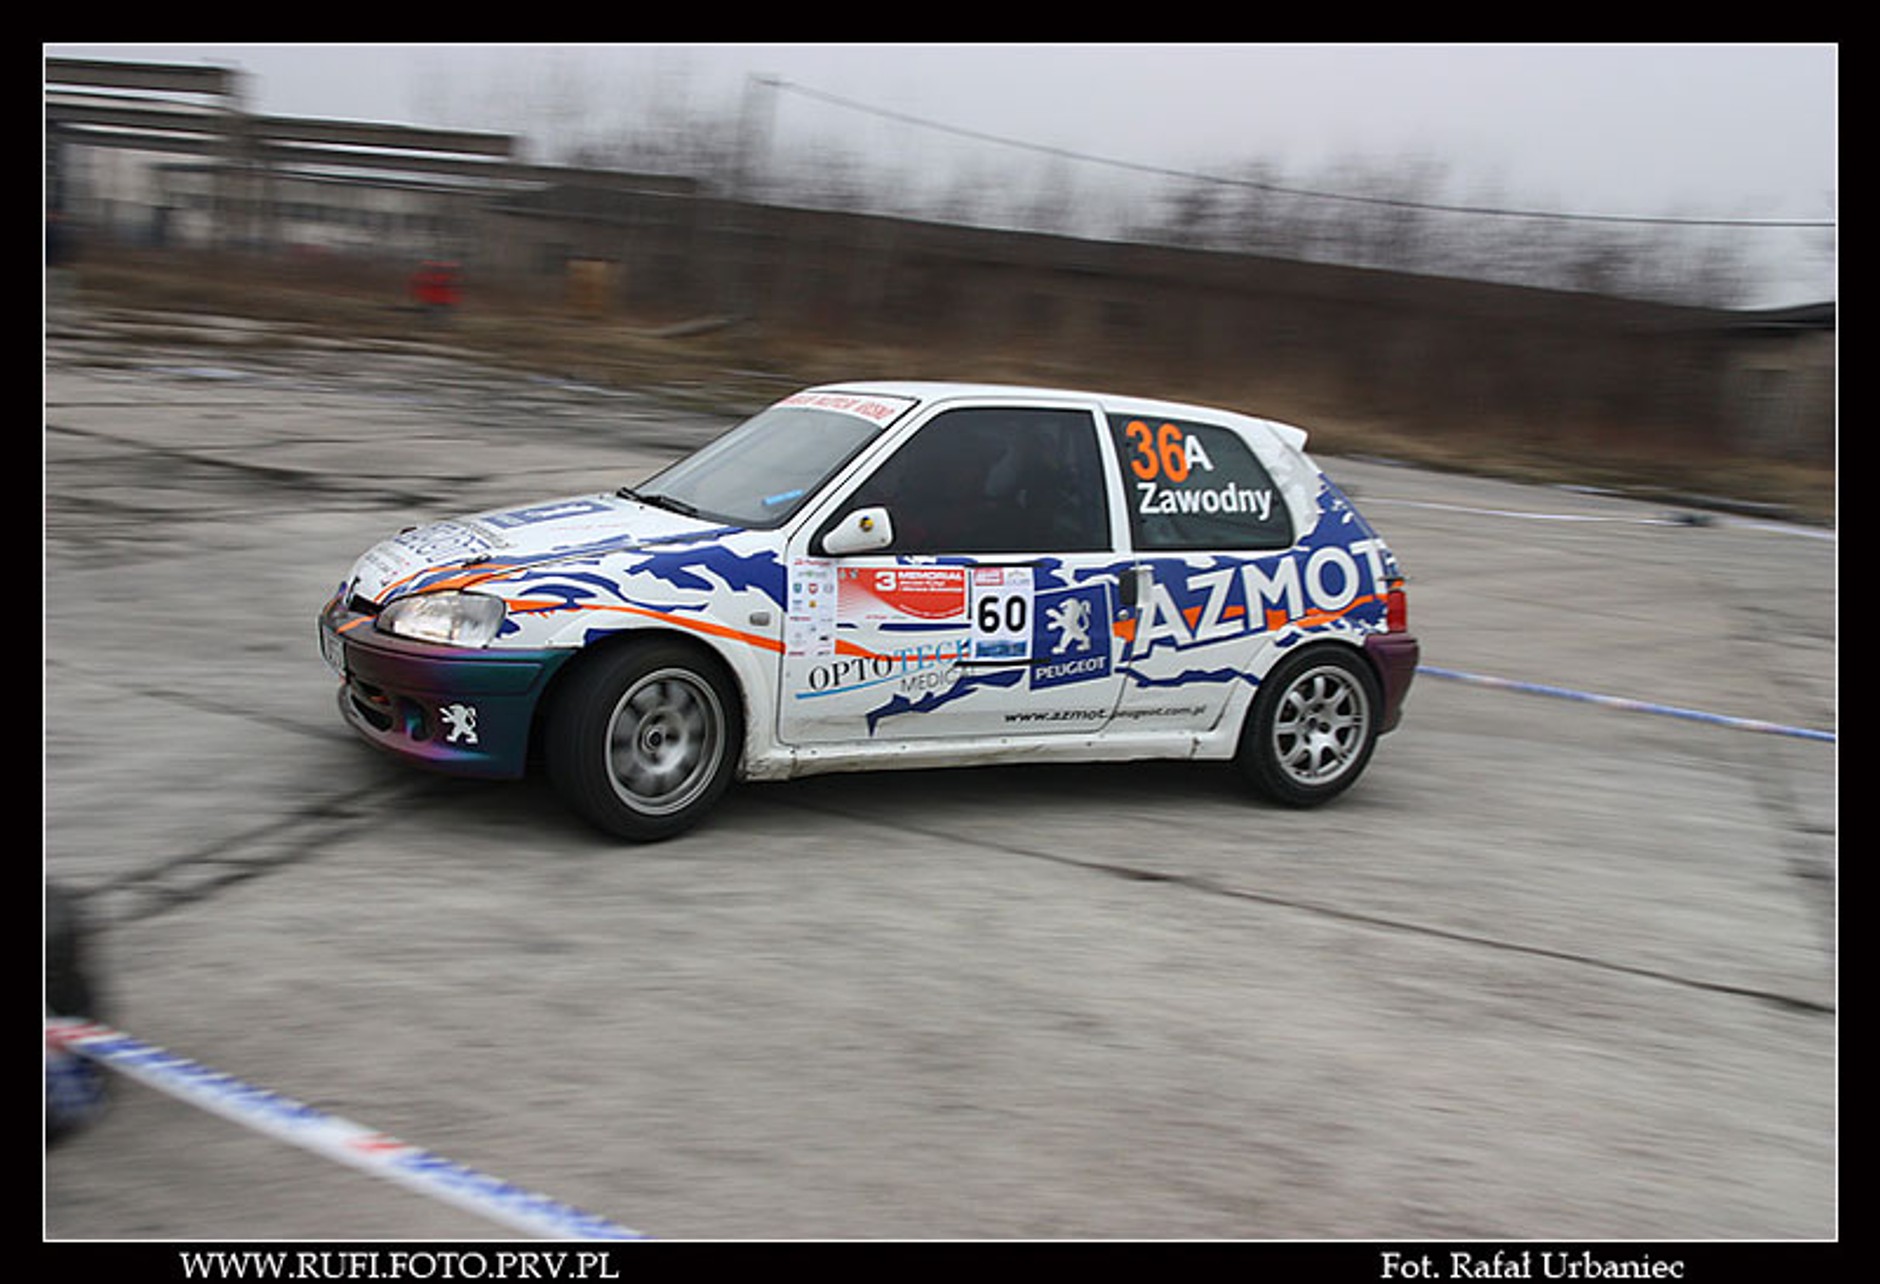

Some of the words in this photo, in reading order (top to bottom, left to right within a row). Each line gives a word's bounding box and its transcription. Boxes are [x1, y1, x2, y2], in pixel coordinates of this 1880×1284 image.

[1136, 482, 1272, 521] Zawodny
[874, 570, 897, 591] 3
[897, 571, 963, 581] MEMORIAL
[1132, 538, 1388, 658] AZMOT
[978, 596, 1026, 634] 60
[1034, 655, 1107, 681] PEUGEOT
